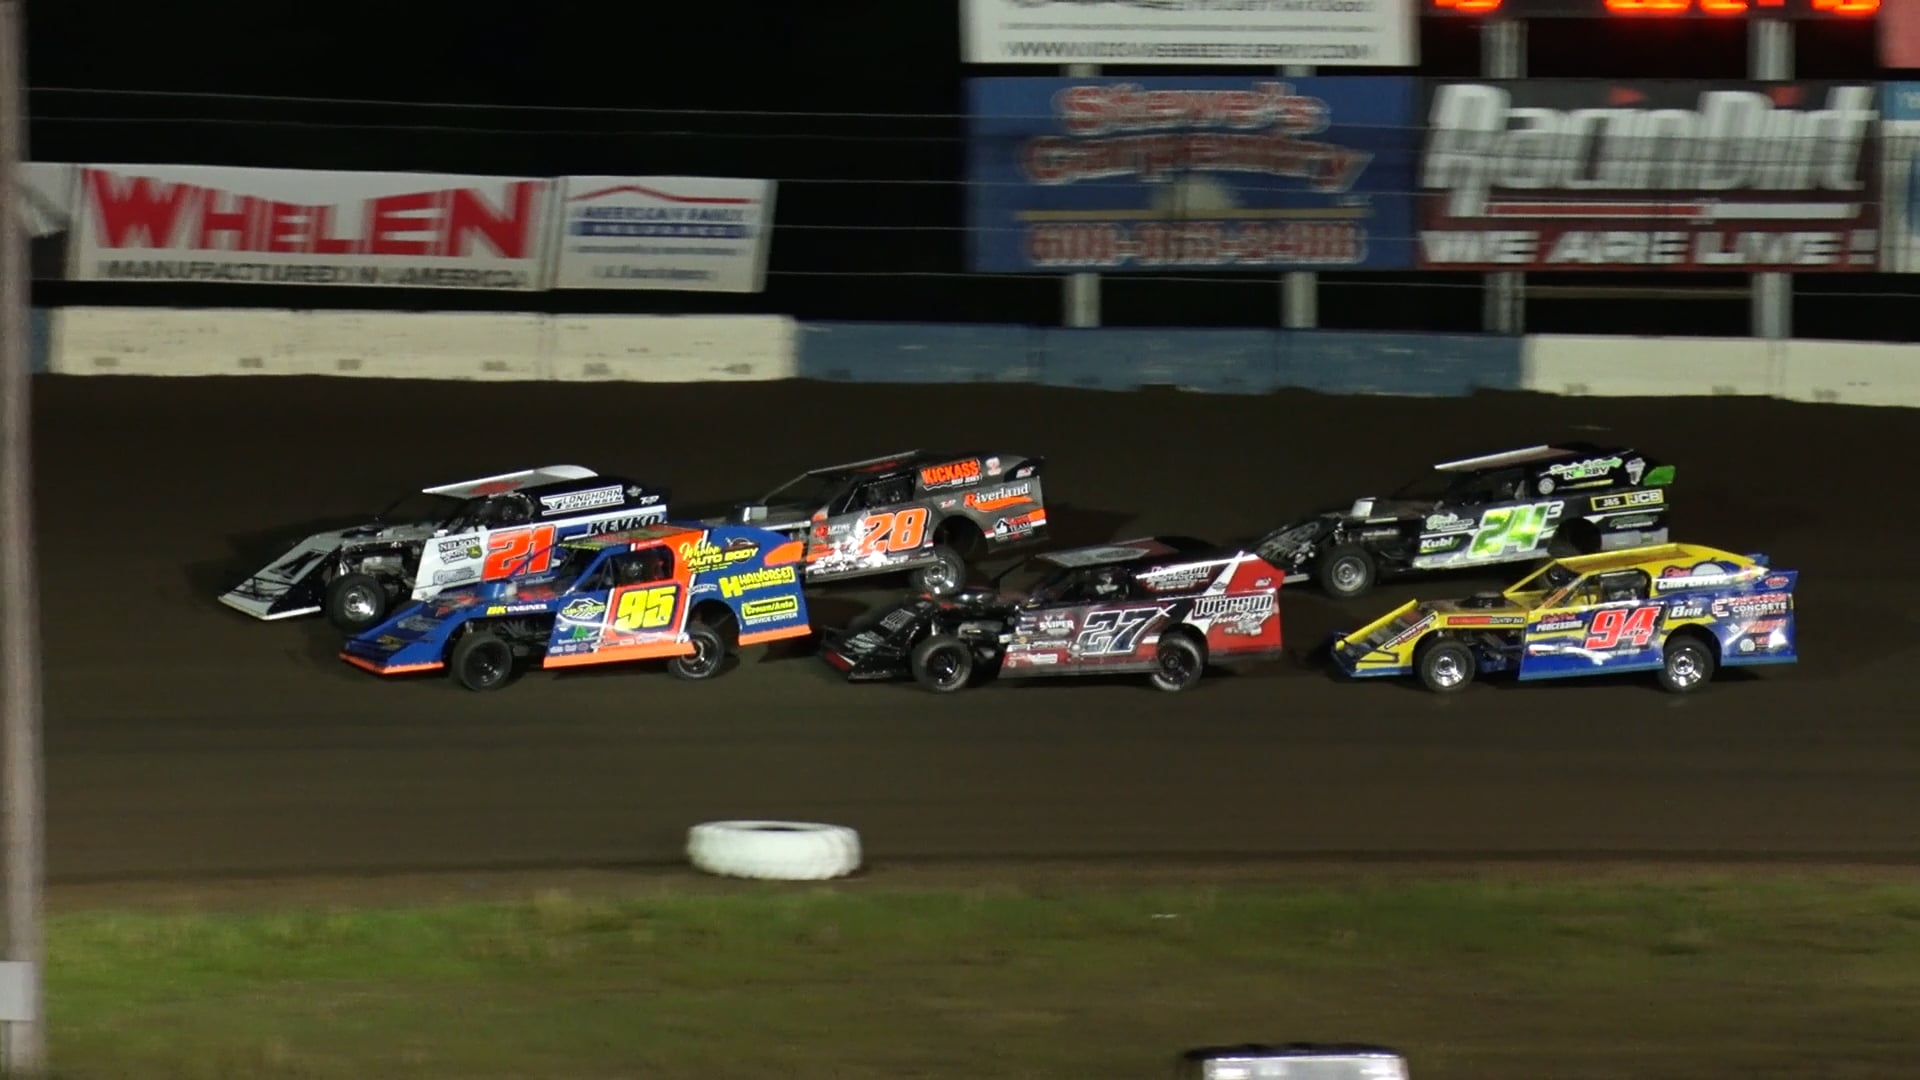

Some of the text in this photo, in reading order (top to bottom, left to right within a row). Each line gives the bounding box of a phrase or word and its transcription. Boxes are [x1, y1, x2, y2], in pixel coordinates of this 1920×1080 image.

[84, 168, 548, 259] WHELEN
[1420, 231, 1540, 264] WE
[1545, 231, 1689, 264] ARE
[921, 459, 980, 485] KICKASS
[562, 488, 622, 505] LONGHORN
[963, 483, 1029, 508] Riverland
[1630, 492, 1660, 504] JCB
[859, 507, 929, 558] 28
[1467, 504, 1550, 559] 24
[439, 537, 480, 553] NELSON
[481, 524, 556, 582] 21
[687, 547, 759, 568] AUTO BODY
[507, 603, 548, 613] ENGINES
[613, 585, 677, 631] 95
[1194, 594, 1274, 618] Iverson
[1732, 601, 1787, 613] CONCRETE
[1584, 606, 1662, 650] 94
